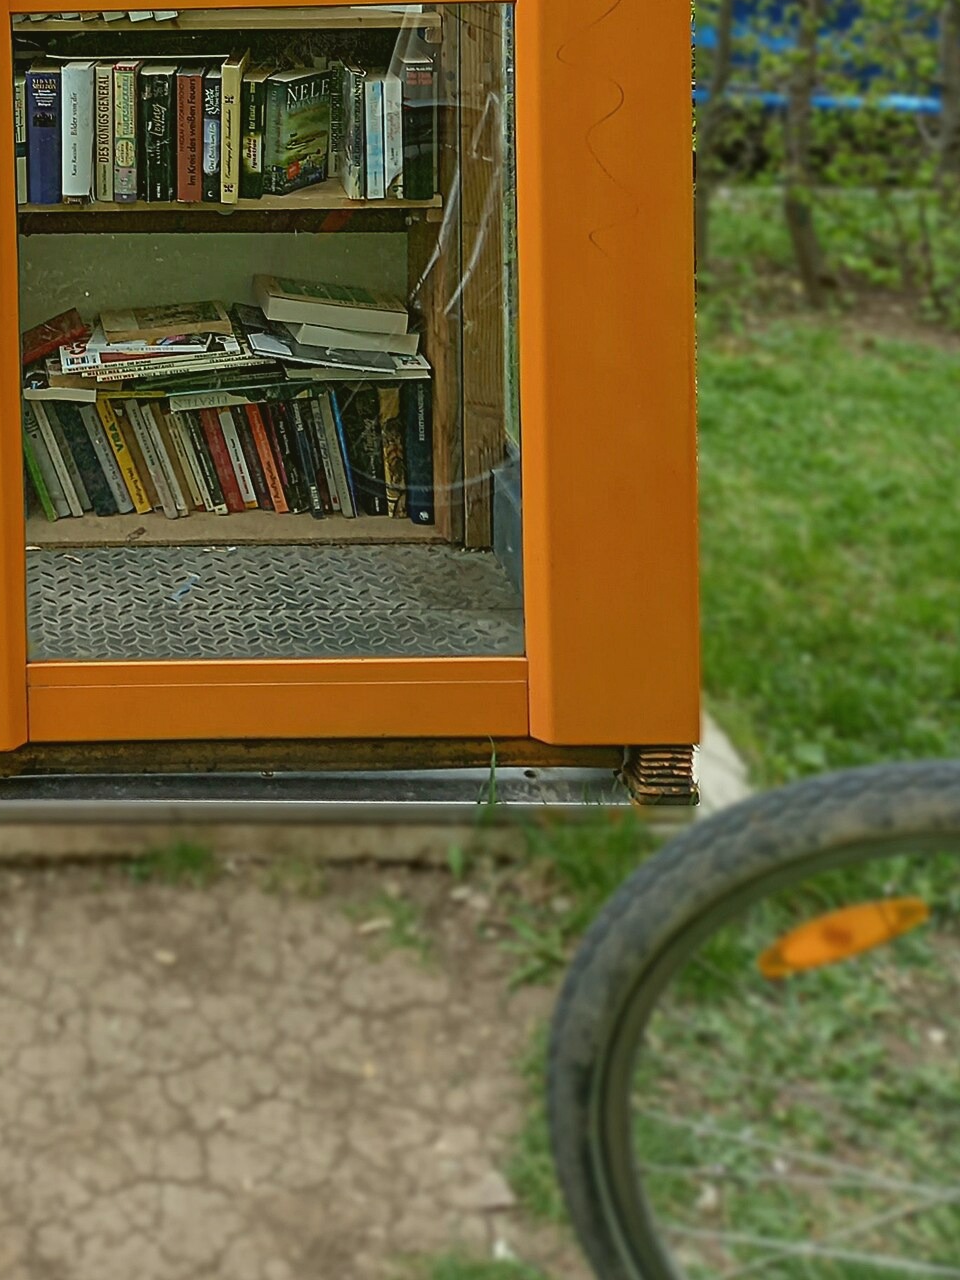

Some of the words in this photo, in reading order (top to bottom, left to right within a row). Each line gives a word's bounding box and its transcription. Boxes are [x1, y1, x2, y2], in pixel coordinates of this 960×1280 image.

[98, 75, 109, 113] GENERAL
[187, 78, 196, 105] Feuers
[287, 79, 330, 104] NELE
[187, 106, 196, 137] weißen
[98, 146, 109, 163] DES
[187, 137, 196, 152] des
[187, 154, 196, 174] Kreis
[188, 175, 196, 186] Im
[131, 479, 144, 505] Wolfgang
